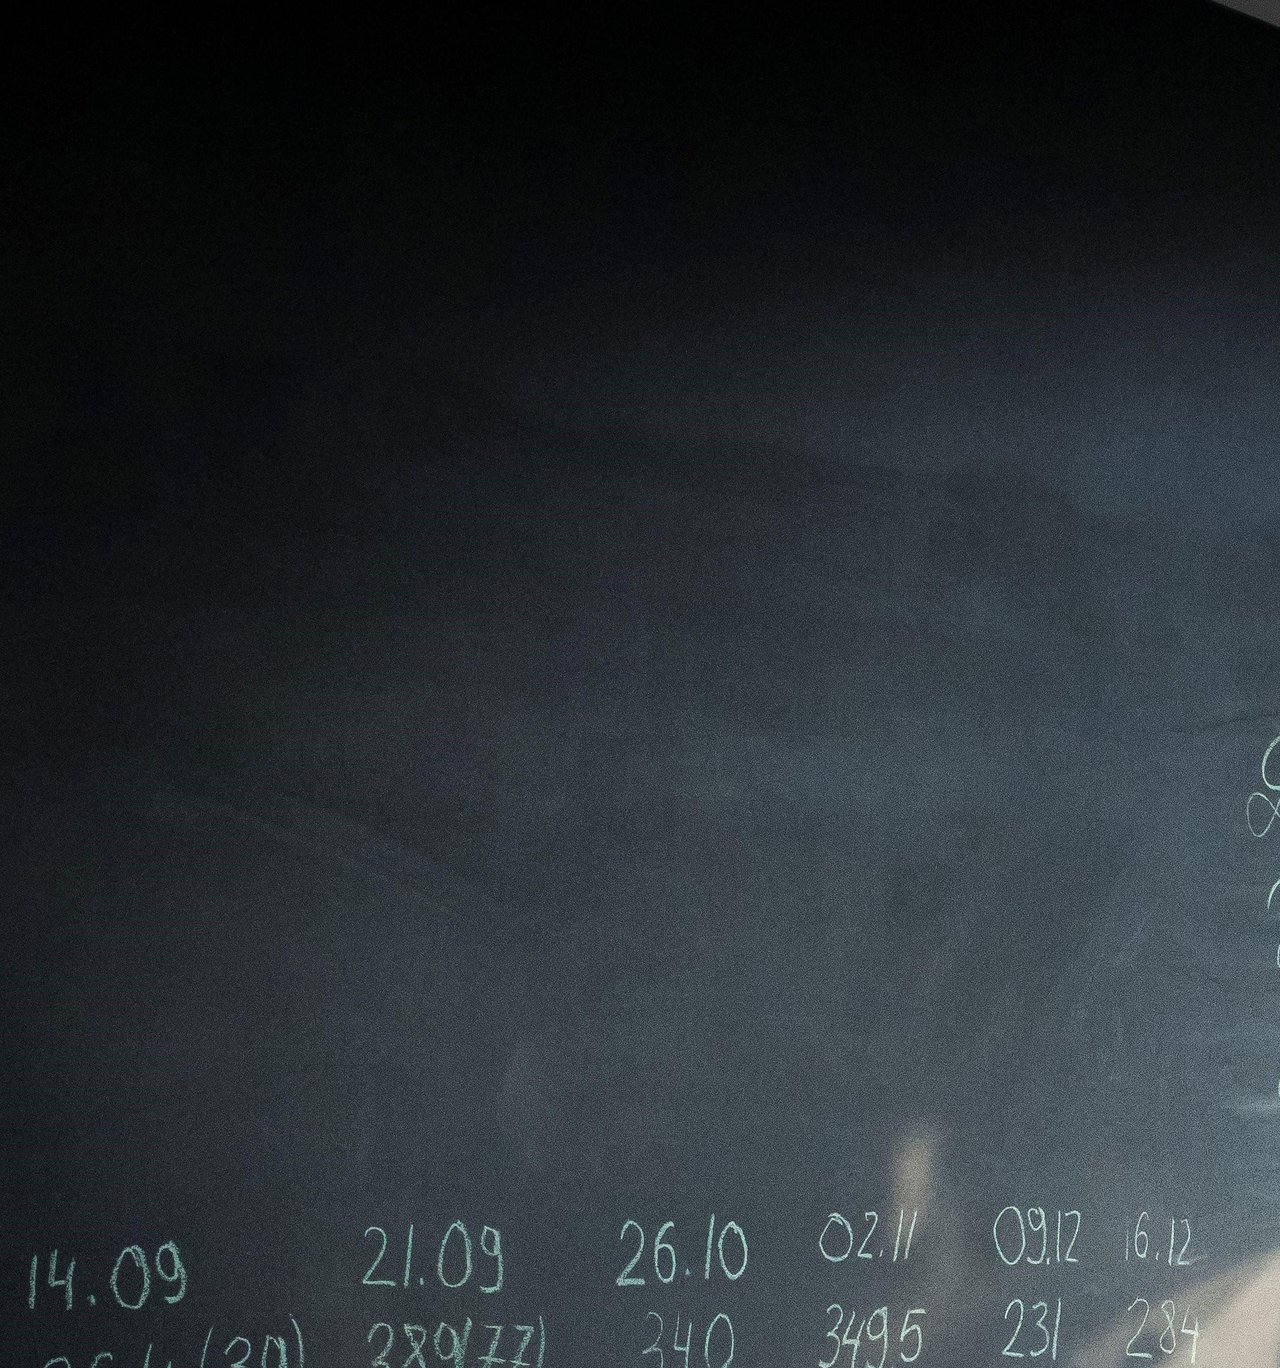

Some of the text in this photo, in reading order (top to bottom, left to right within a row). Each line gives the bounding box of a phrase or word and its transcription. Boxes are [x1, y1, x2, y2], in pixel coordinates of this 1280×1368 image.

[361, 1219, 502, 1294] 21.09
[616, 1213, 748, 1286] 26.10
[819, 1211, 918, 1263] 02.11
[993, 1205, 1081, 1266] 09.12
[1124, 1211, 1194, 1266] 16.12
[28, 1241, 188, 1311] 14.09
[1002, 1298, 1062, 1360] 231
[1125, 1298, 1200, 1364] 284
